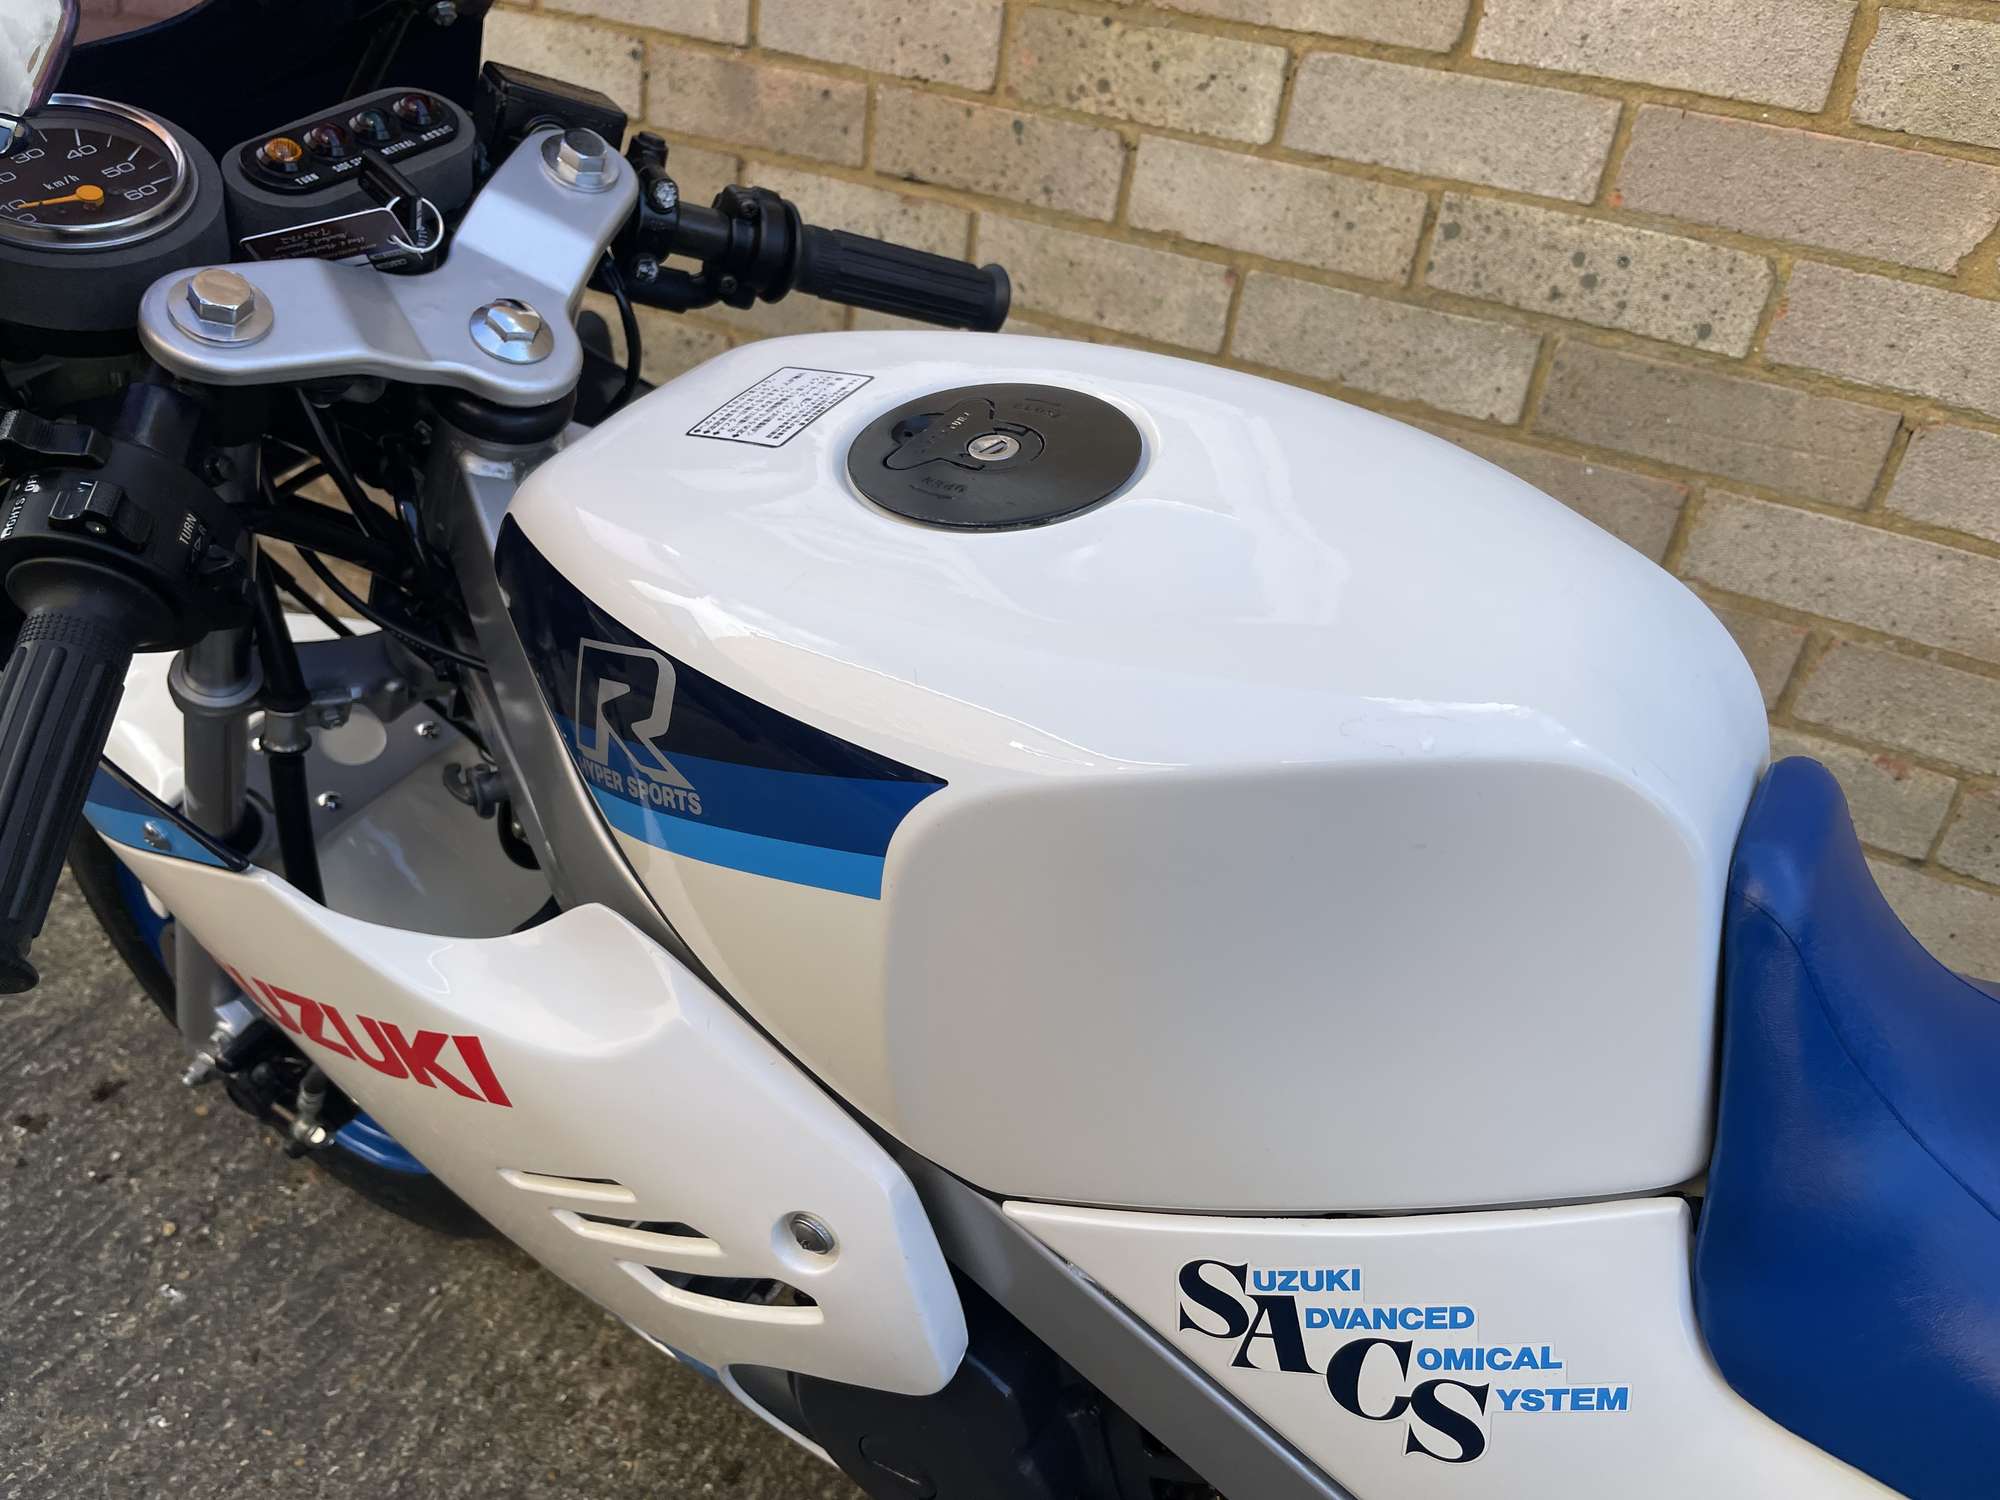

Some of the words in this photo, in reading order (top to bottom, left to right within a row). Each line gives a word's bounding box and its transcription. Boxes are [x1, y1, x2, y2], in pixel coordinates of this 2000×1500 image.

[10, 147, 45, 164] 30
[67, 144, 98, 160] 40
[0, 170, 16, 186] 0
[101, 161, 136, 178] 50
[42, 173, 82, 191] km/h
[294, 172, 320, 186] TURN
[124, 184, 159, 201] 60
[178, 512, 198, 546] TURN
[575, 636, 697, 791] R
[627, 774, 703, 817] SPORTS
[222, 962, 513, 1108] UZUKI
